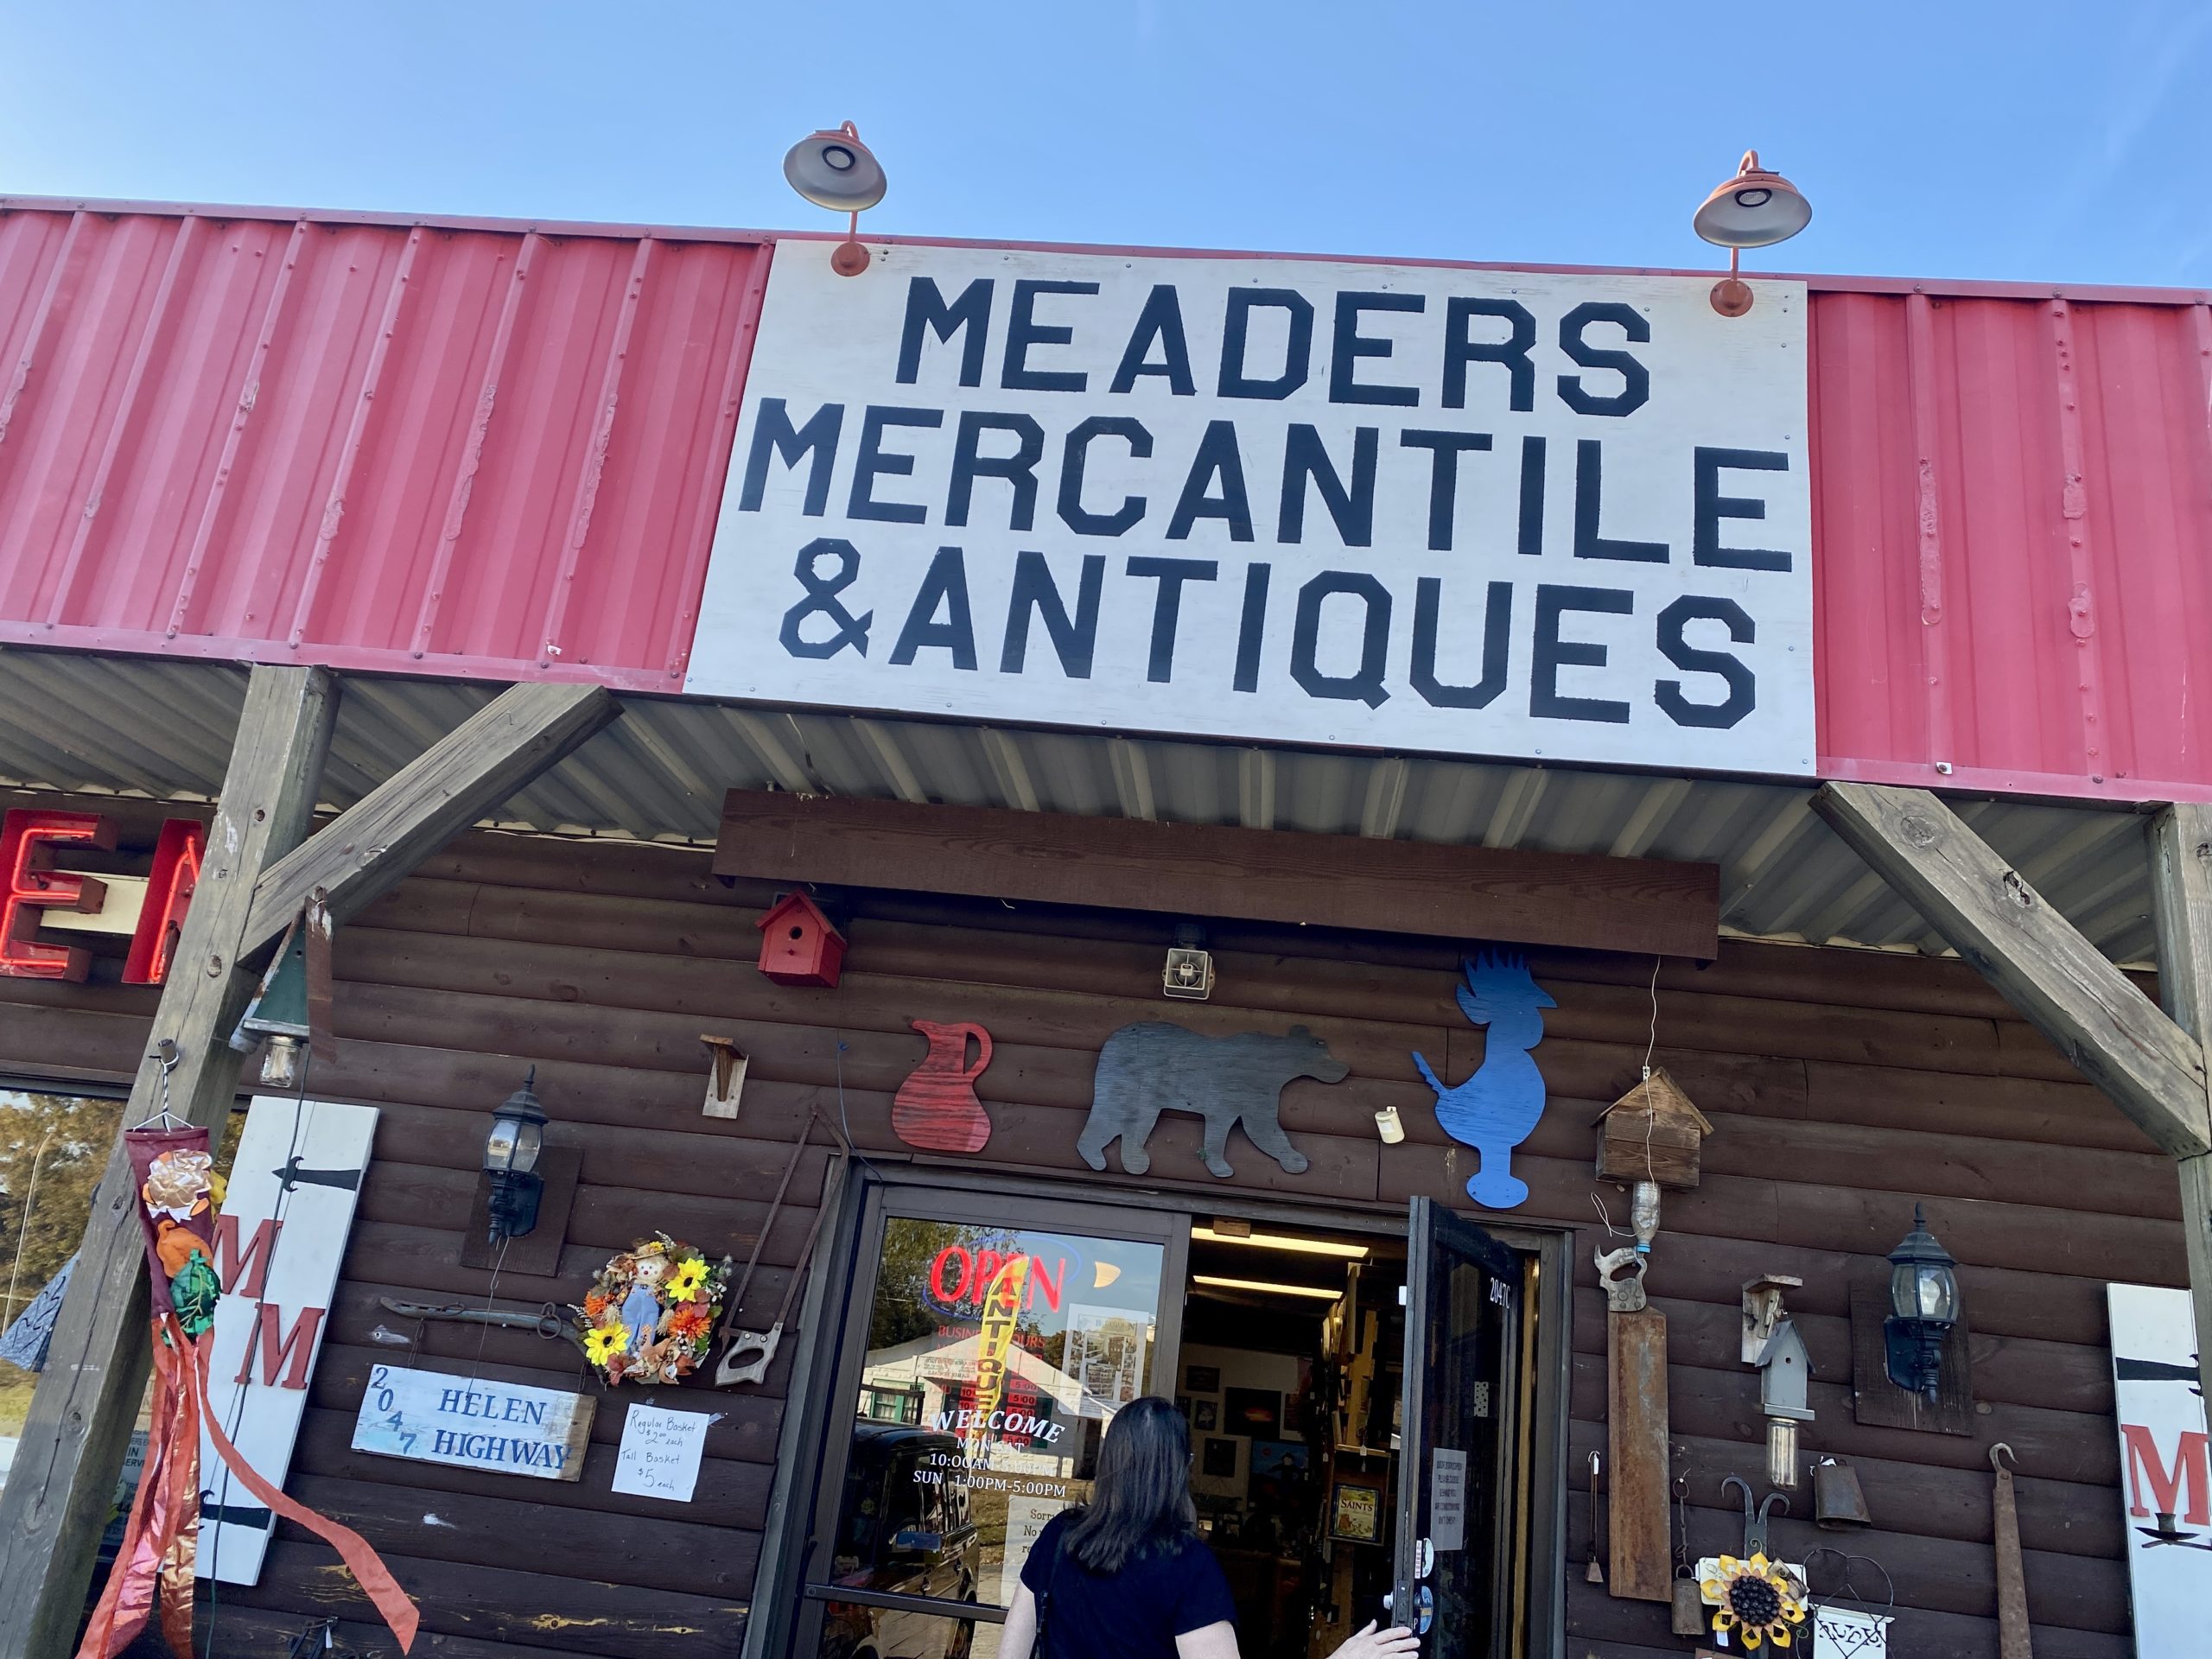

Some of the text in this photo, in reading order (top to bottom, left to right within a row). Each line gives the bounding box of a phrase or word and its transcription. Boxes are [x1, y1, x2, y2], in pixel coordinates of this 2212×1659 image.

[896, 277, 1649, 417] MEADERS
[739, 398, 1791, 572] MERCANTILE
[931, 1245, 1065, 1313] OPEN
[234, 1302, 326, 1390] M
[437, 1388, 547, 1426] HELEN
[630, 1409, 696, 1434] Regular Basket
[665, 1438, 683, 1446] each
[930, 1409, 1066, 1443] WELCOME
[431, 1429, 572, 1469] HIGHWAY
[621, 1449, 680, 1465] Tall Basket
[638, 1468, 674, 1491] $5 each
[913, 1471, 1066, 1497] SUN 1:00PM-5:00PM
[2121, 1424, 2212, 1526] M
[1341, 1499, 1372, 1511] SAINTS
[1024, 1525, 1037, 1536] No
